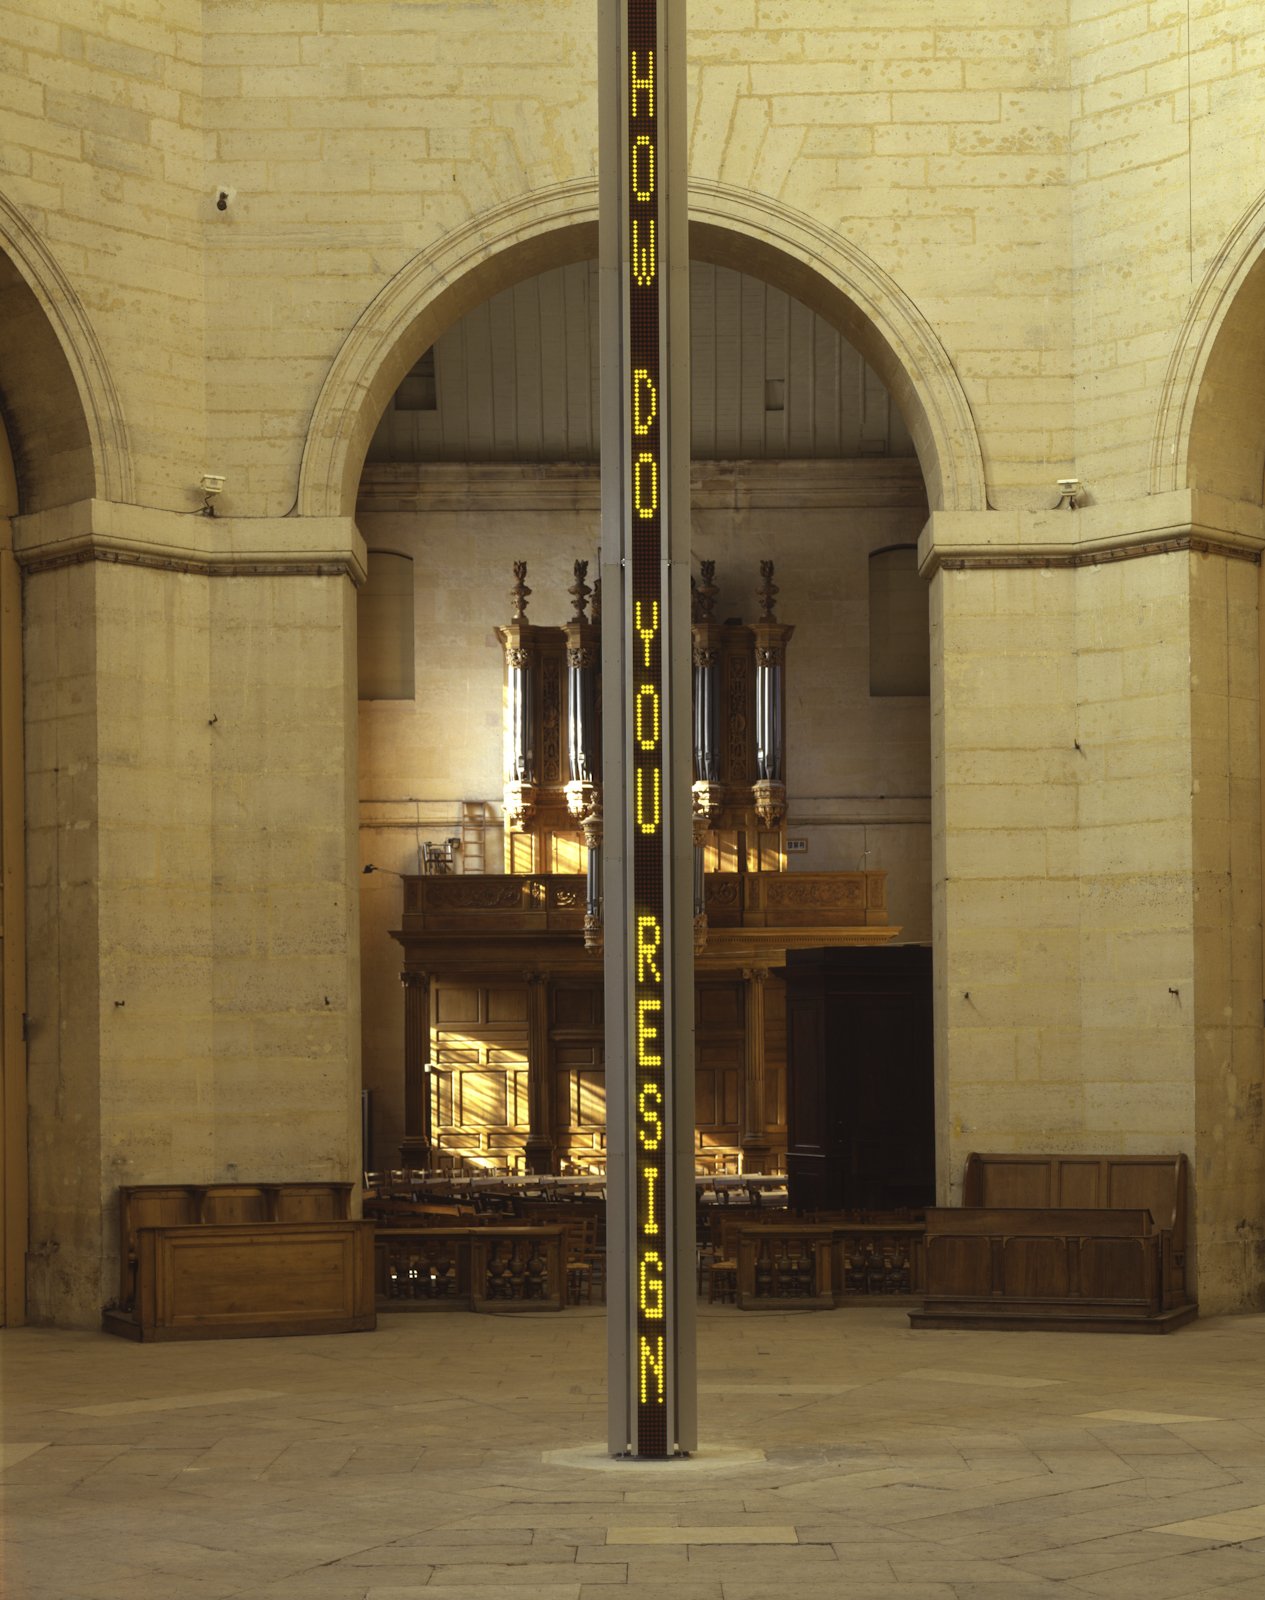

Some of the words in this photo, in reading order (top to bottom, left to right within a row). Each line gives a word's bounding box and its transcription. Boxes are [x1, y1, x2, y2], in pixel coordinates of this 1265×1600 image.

[631, 50, 656, 286] HOW
[633, 368, 658, 519] DO
[634, 600, 660, 834] YOU
[637, 915, 664, 1404] RESIGN
